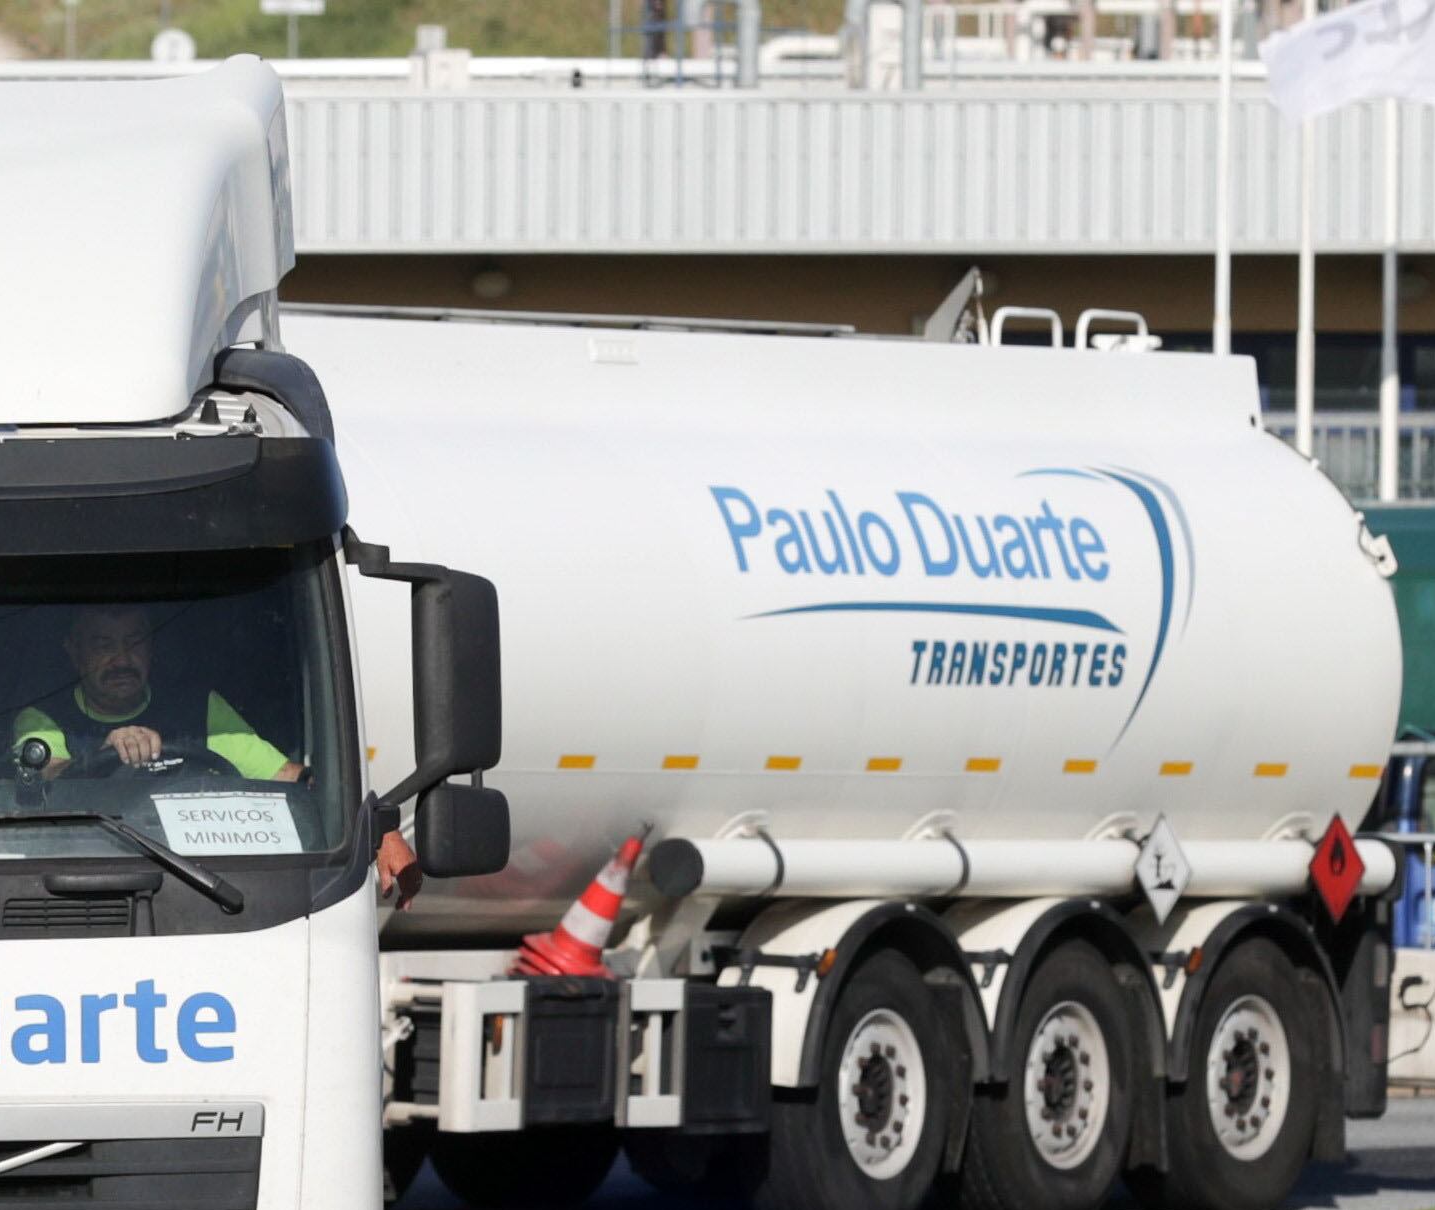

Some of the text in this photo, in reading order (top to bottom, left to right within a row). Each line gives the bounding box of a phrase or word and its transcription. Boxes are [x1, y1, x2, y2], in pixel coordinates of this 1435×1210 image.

[708, 486, 1111, 582] Paulo Duarte
[909, 640, 1128, 688] TRANSPORTES
[177, 809, 274, 825] SERVIÇOS
[190, 1110, 245, 1133] FH
